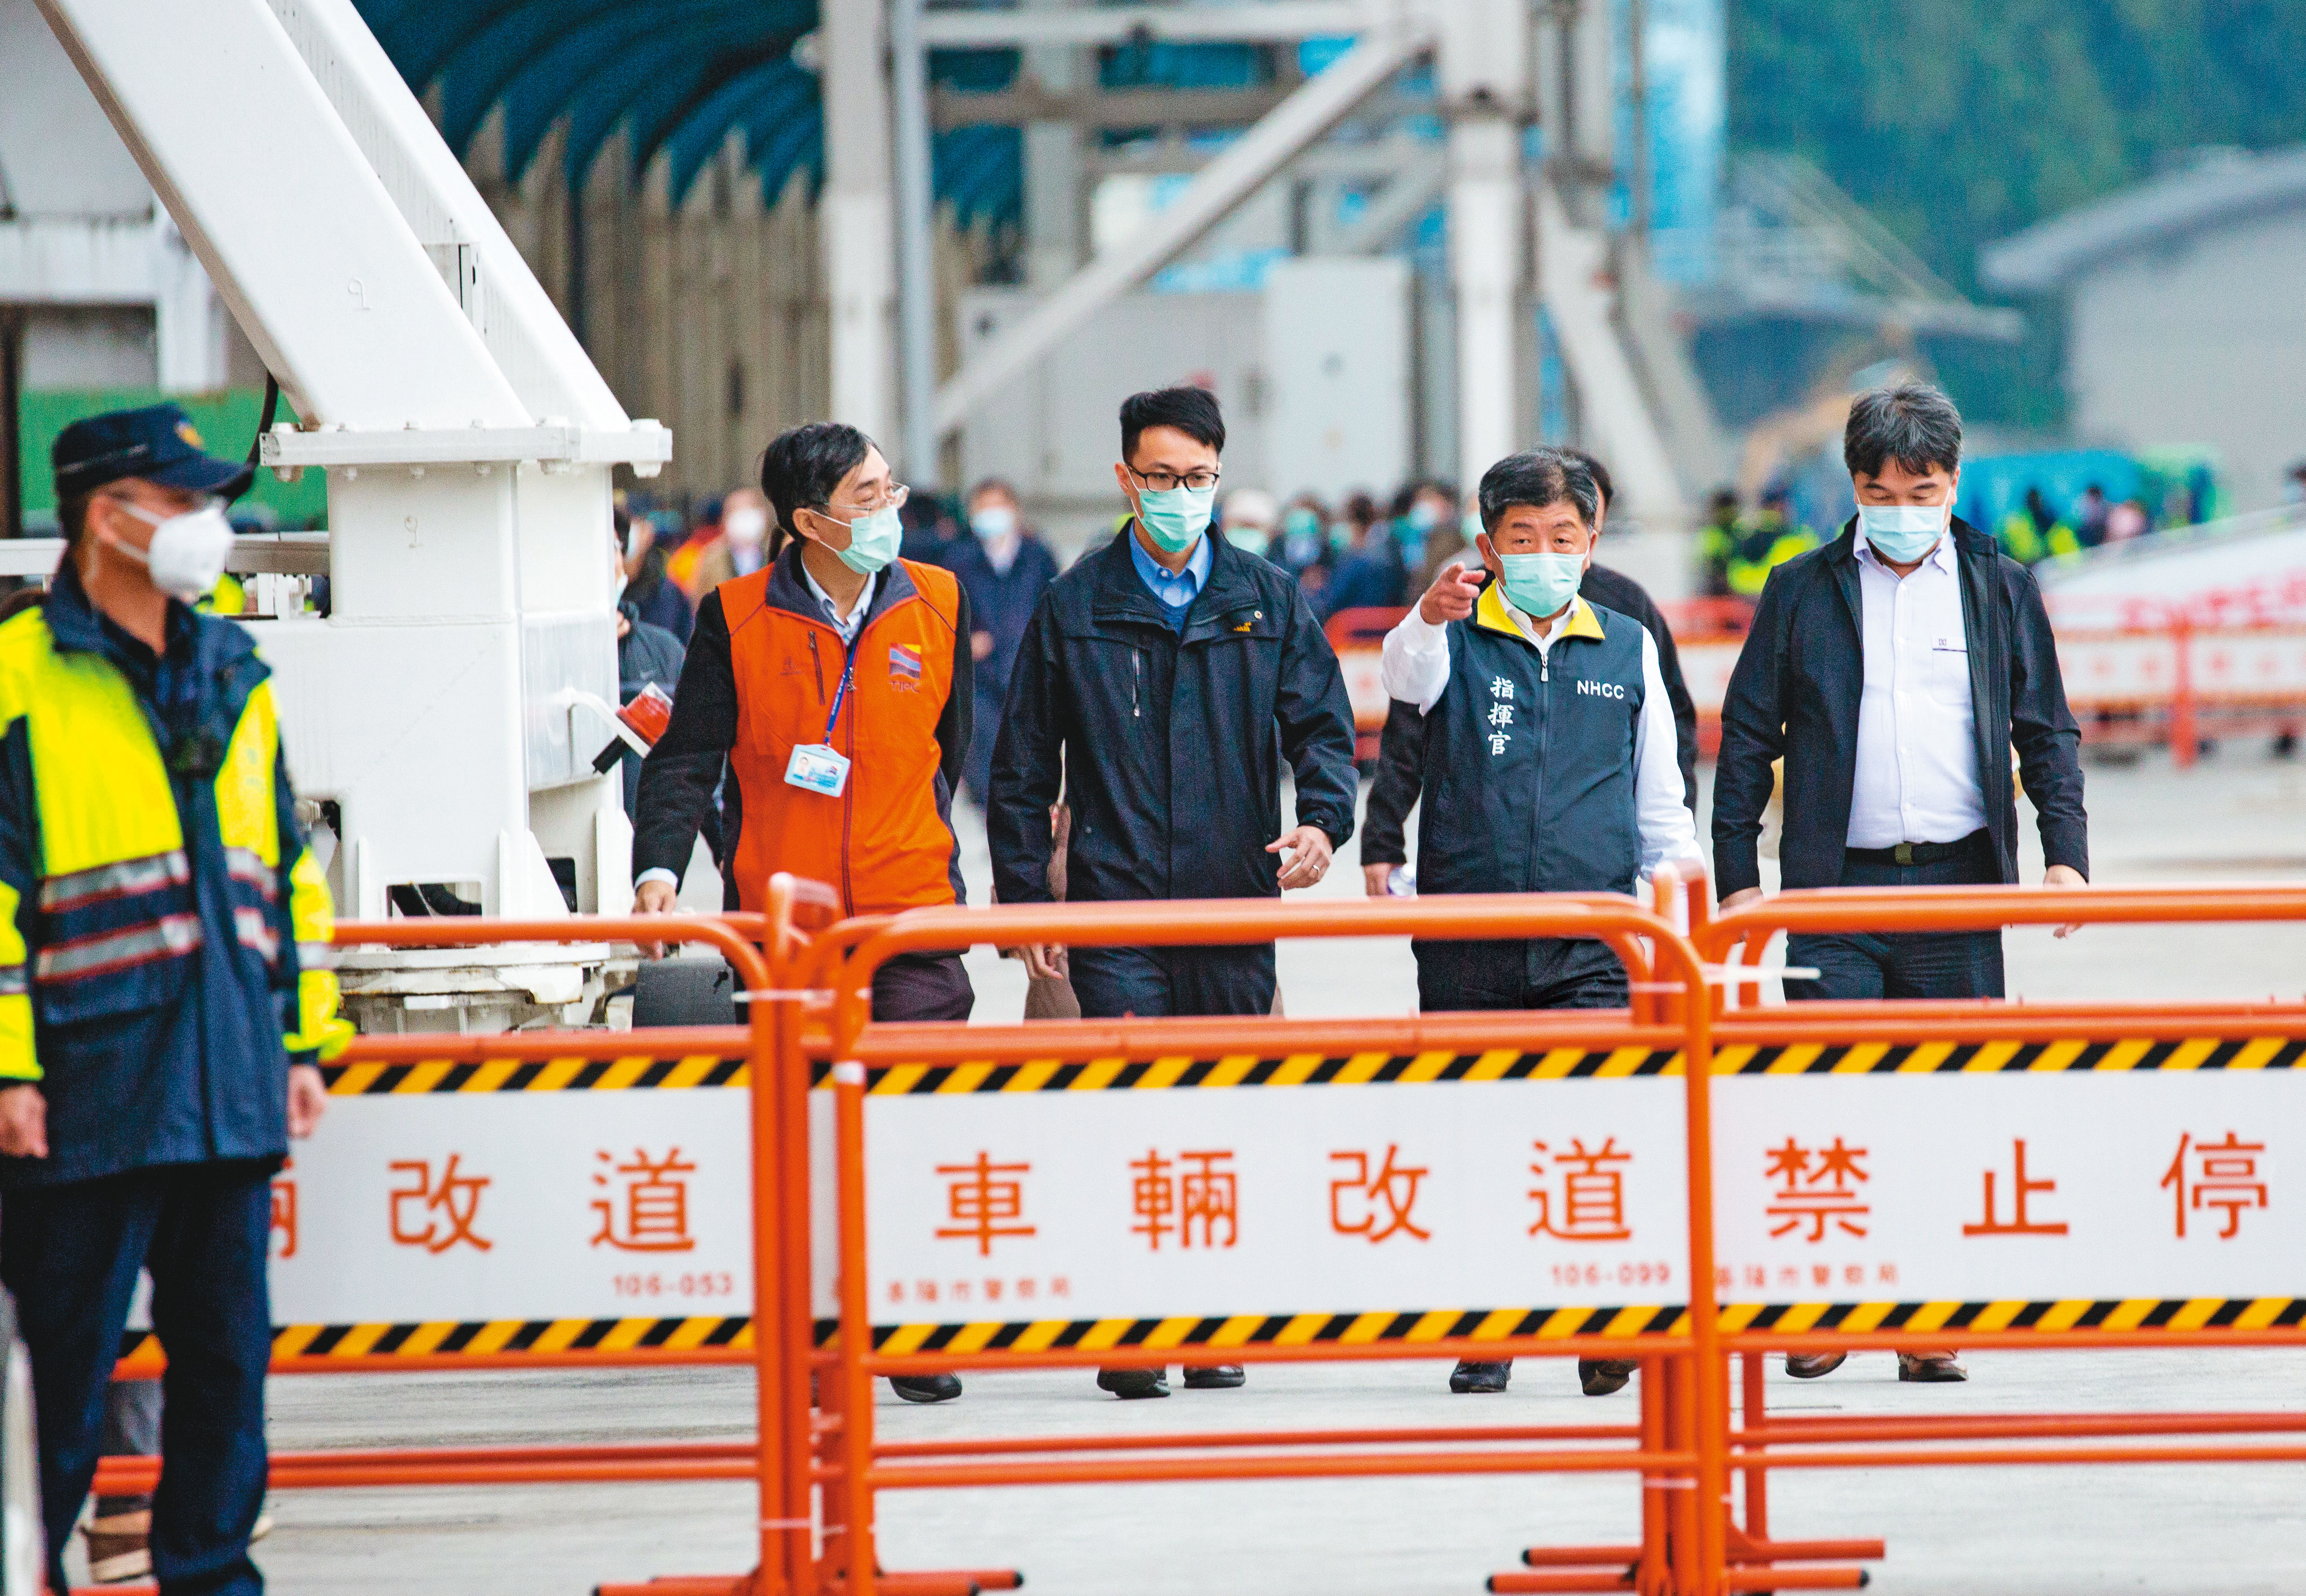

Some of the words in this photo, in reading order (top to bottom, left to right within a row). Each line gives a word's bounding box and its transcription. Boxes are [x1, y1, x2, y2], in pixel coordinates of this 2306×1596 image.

[1487, 676, 1515, 756] 指揮官
[1577, 680, 1624, 700] NHCC
[266, 1146, 697, 1258] 改道
[934, 1135, 1633, 1257] 車輛改道
[1764, 1130, 2269, 1244] 禁止停
[612, 1272, 733, 1297] 106-053
[1551, 1261, 1671, 1286] 106-099
